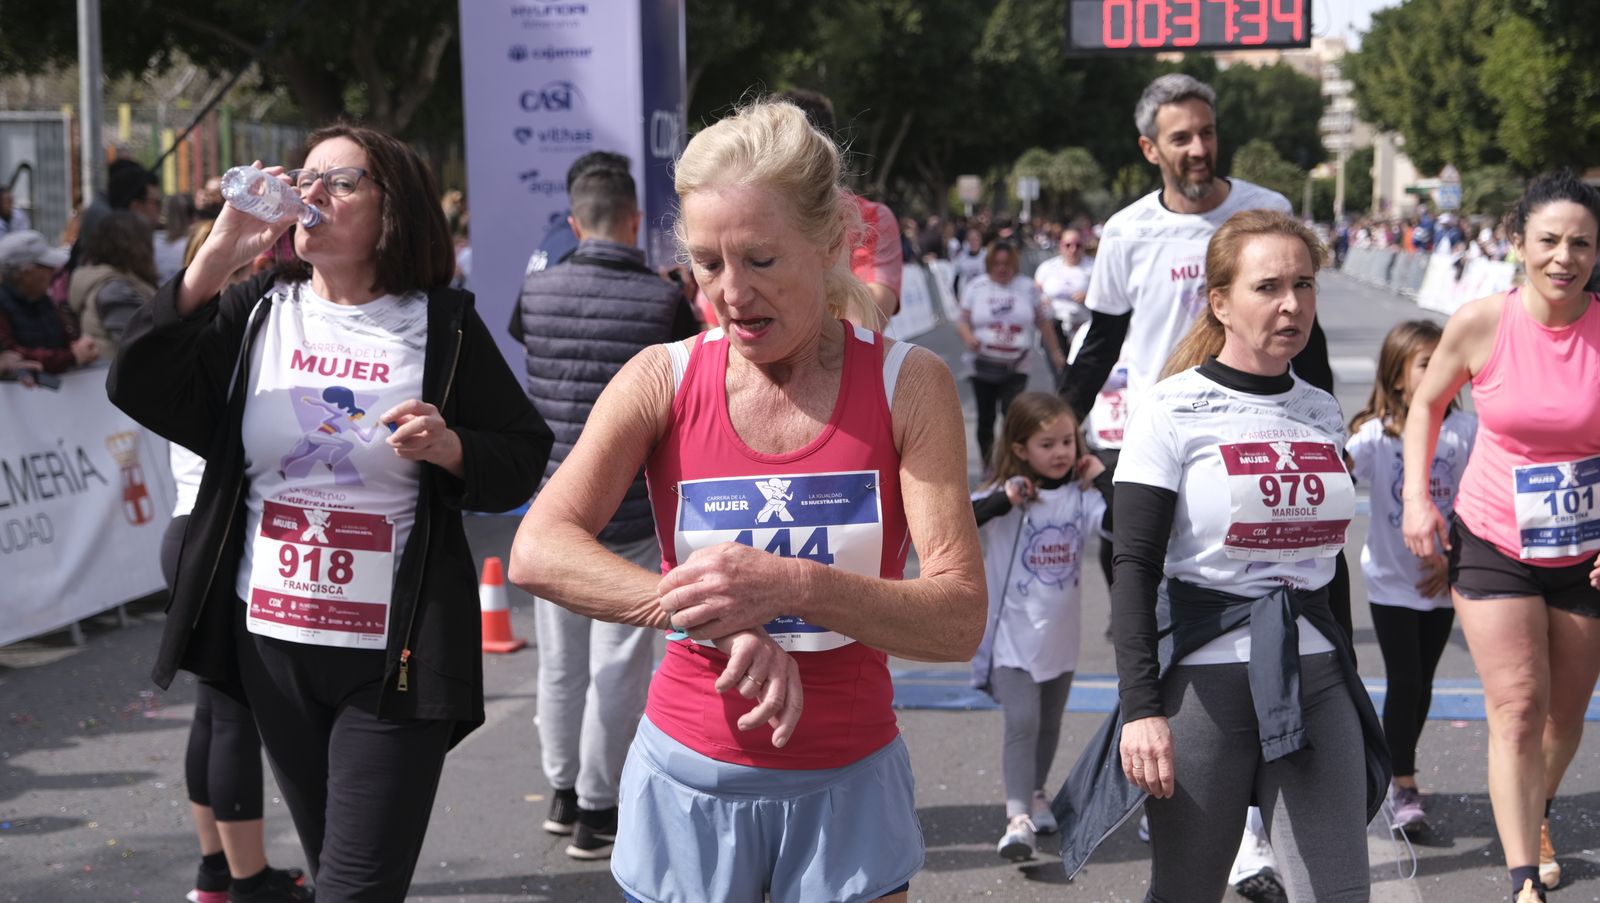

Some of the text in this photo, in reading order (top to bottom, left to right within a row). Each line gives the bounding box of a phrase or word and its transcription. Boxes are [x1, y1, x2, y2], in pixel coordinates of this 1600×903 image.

[1103, 0, 1303, 48] 00:37:34
[302, 340, 387, 359] CARRERA DE LA
[290, 349, 390, 383] MUJER
[1241, 429, 1311, 439] CARRERA DE LA
[1240, 455, 1270, 464] MUJER
[0, 437, 108, 510] MERÍA
[1259, 474, 1325, 507] 979
[704, 500, 749, 512] MUJER
[1544, 486, 1594, 515] 101
[1271, 507, 1317, 517] MARISOLE
[272, 518, 298, 530] MUJER
[278, 544, 354, 585] 918
[283, 579, 344, 595] FRANCISCA
